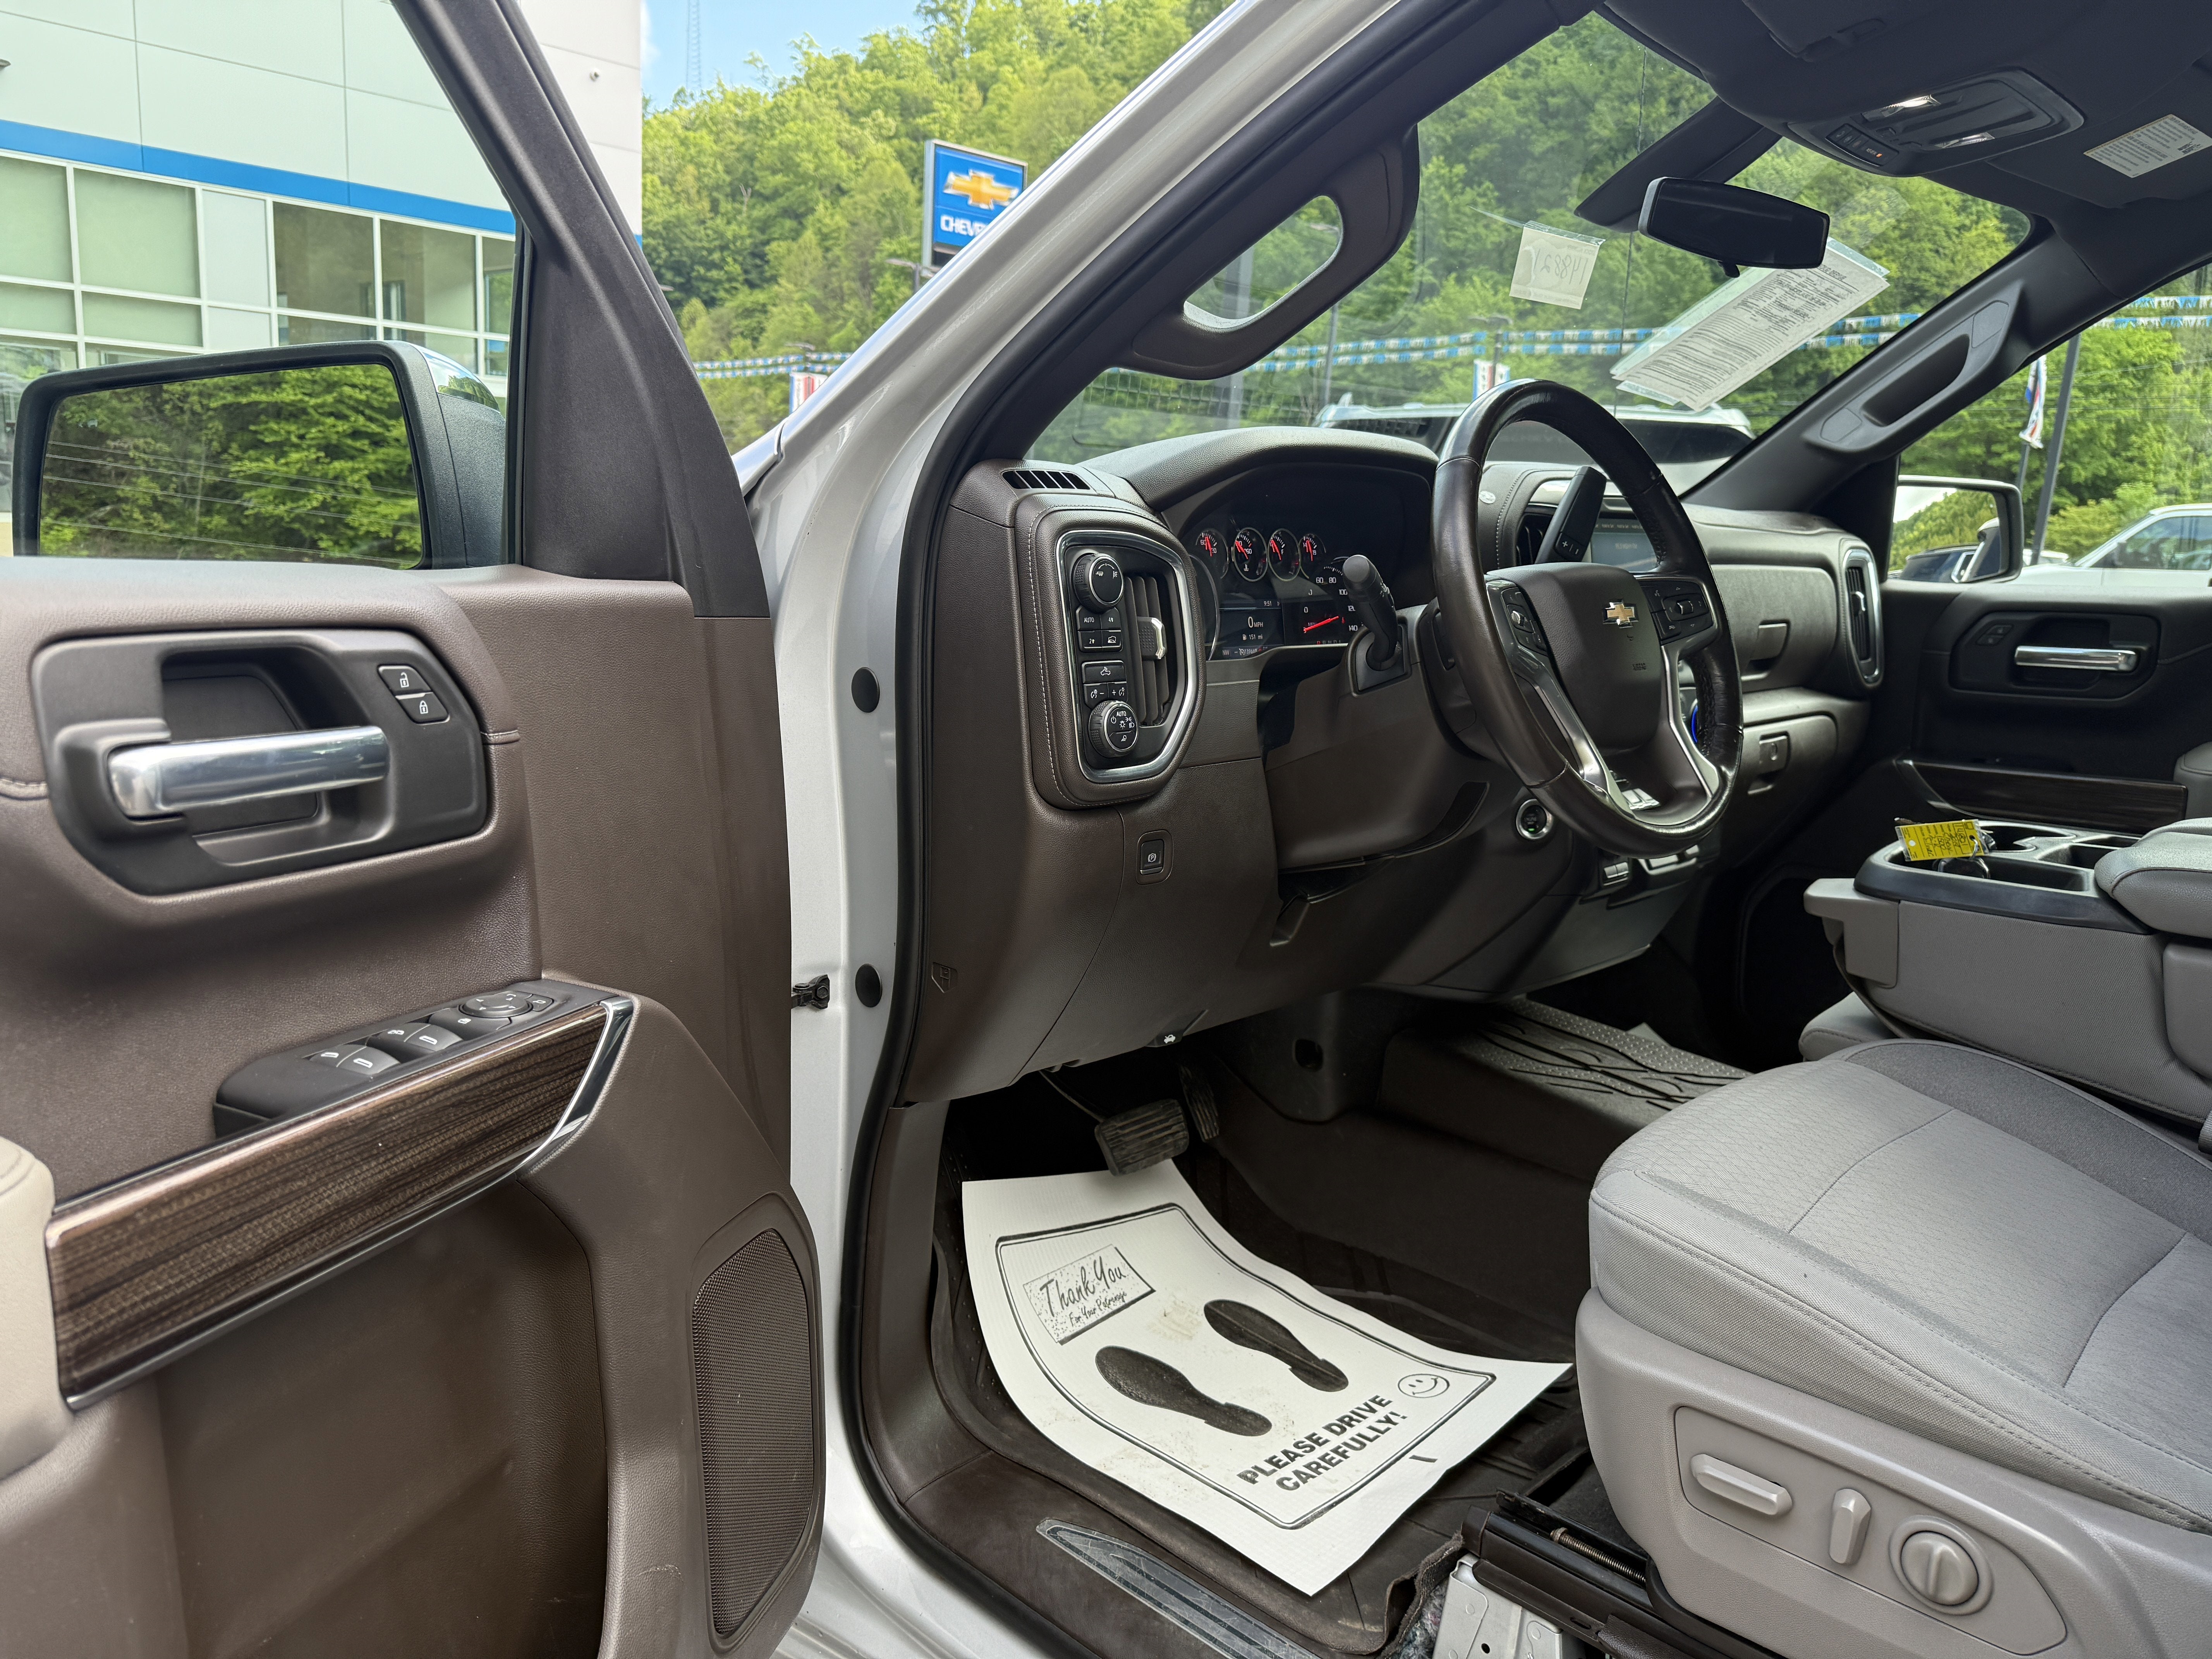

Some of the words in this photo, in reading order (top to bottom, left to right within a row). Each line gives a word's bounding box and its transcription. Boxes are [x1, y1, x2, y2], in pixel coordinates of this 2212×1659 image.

[1248, 616, 1253, 628] 0
[1039, 1266, 1095, 1317] Thank
[1093, 1255, 1127, 1290] You
[1069, 1312, 1082, 1327] For
[1081, 1305, 1096, 1319] Your
[1096, 1291, 1127, 1311] Patronage
[1236, 1432, 1331, 1484] PLEASE
[1322, 1395, 1393, 1436] DRIVE
[1276, 1411, 1408, 1491] CAREFULLY!
